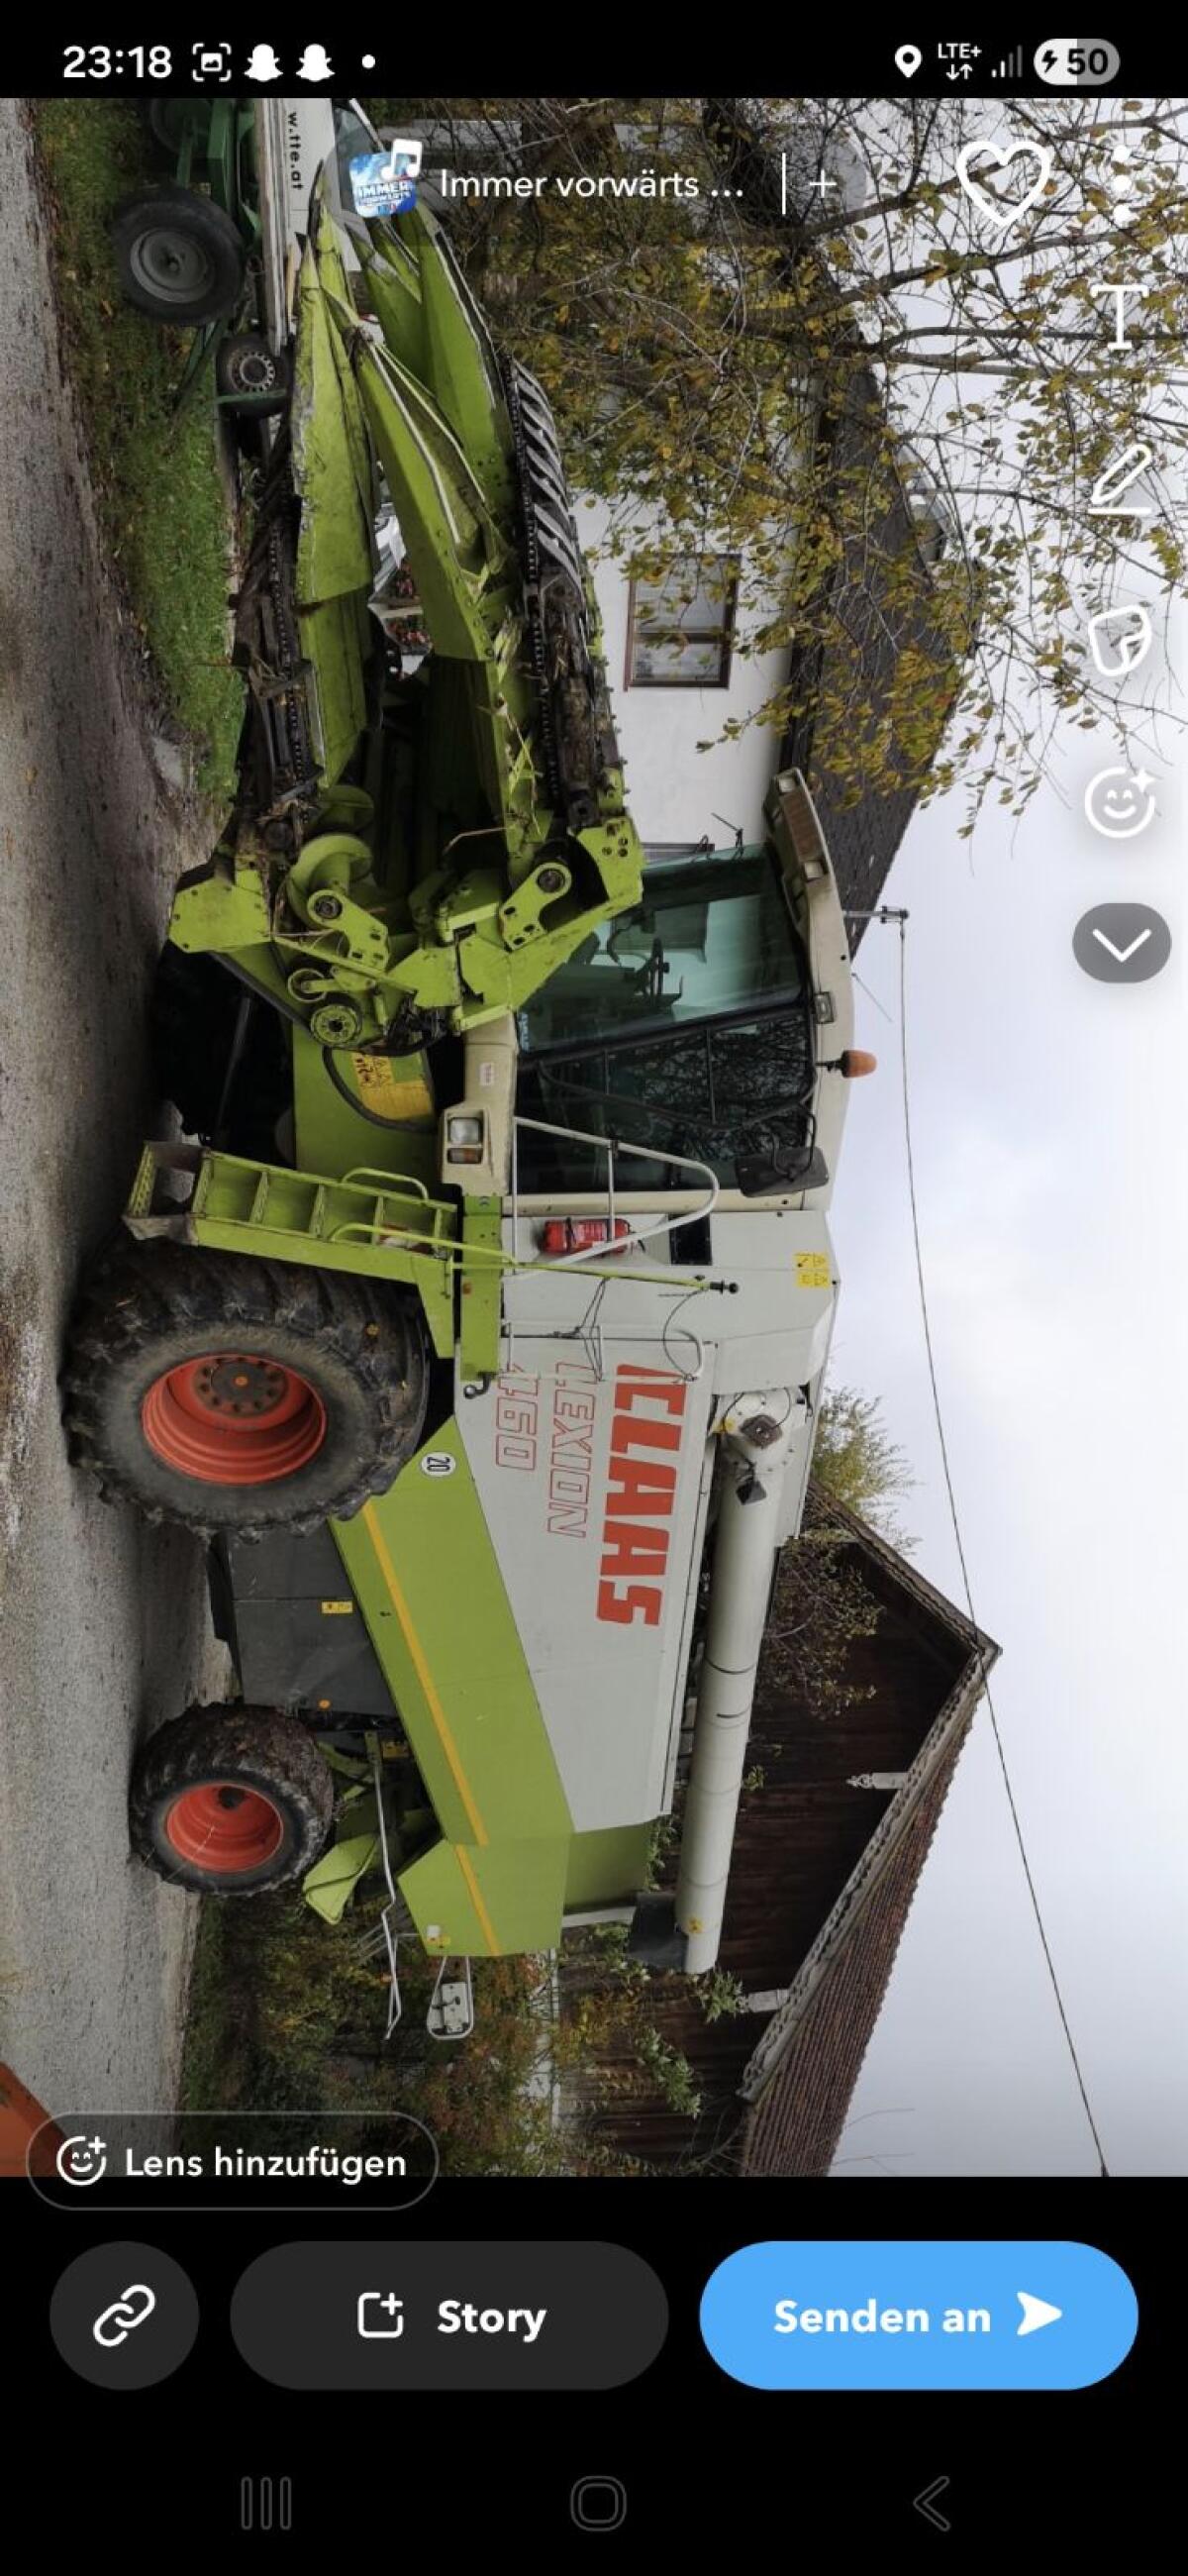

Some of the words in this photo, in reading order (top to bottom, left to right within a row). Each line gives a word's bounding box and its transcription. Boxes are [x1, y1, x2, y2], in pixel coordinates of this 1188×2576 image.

[426, 1456, 451, 1473] 20
[496, 1363, 539, 1471] 460
[547, 1363, 597, 1538] LEXION
[597, 1365, 687, 1625] CLAAS
